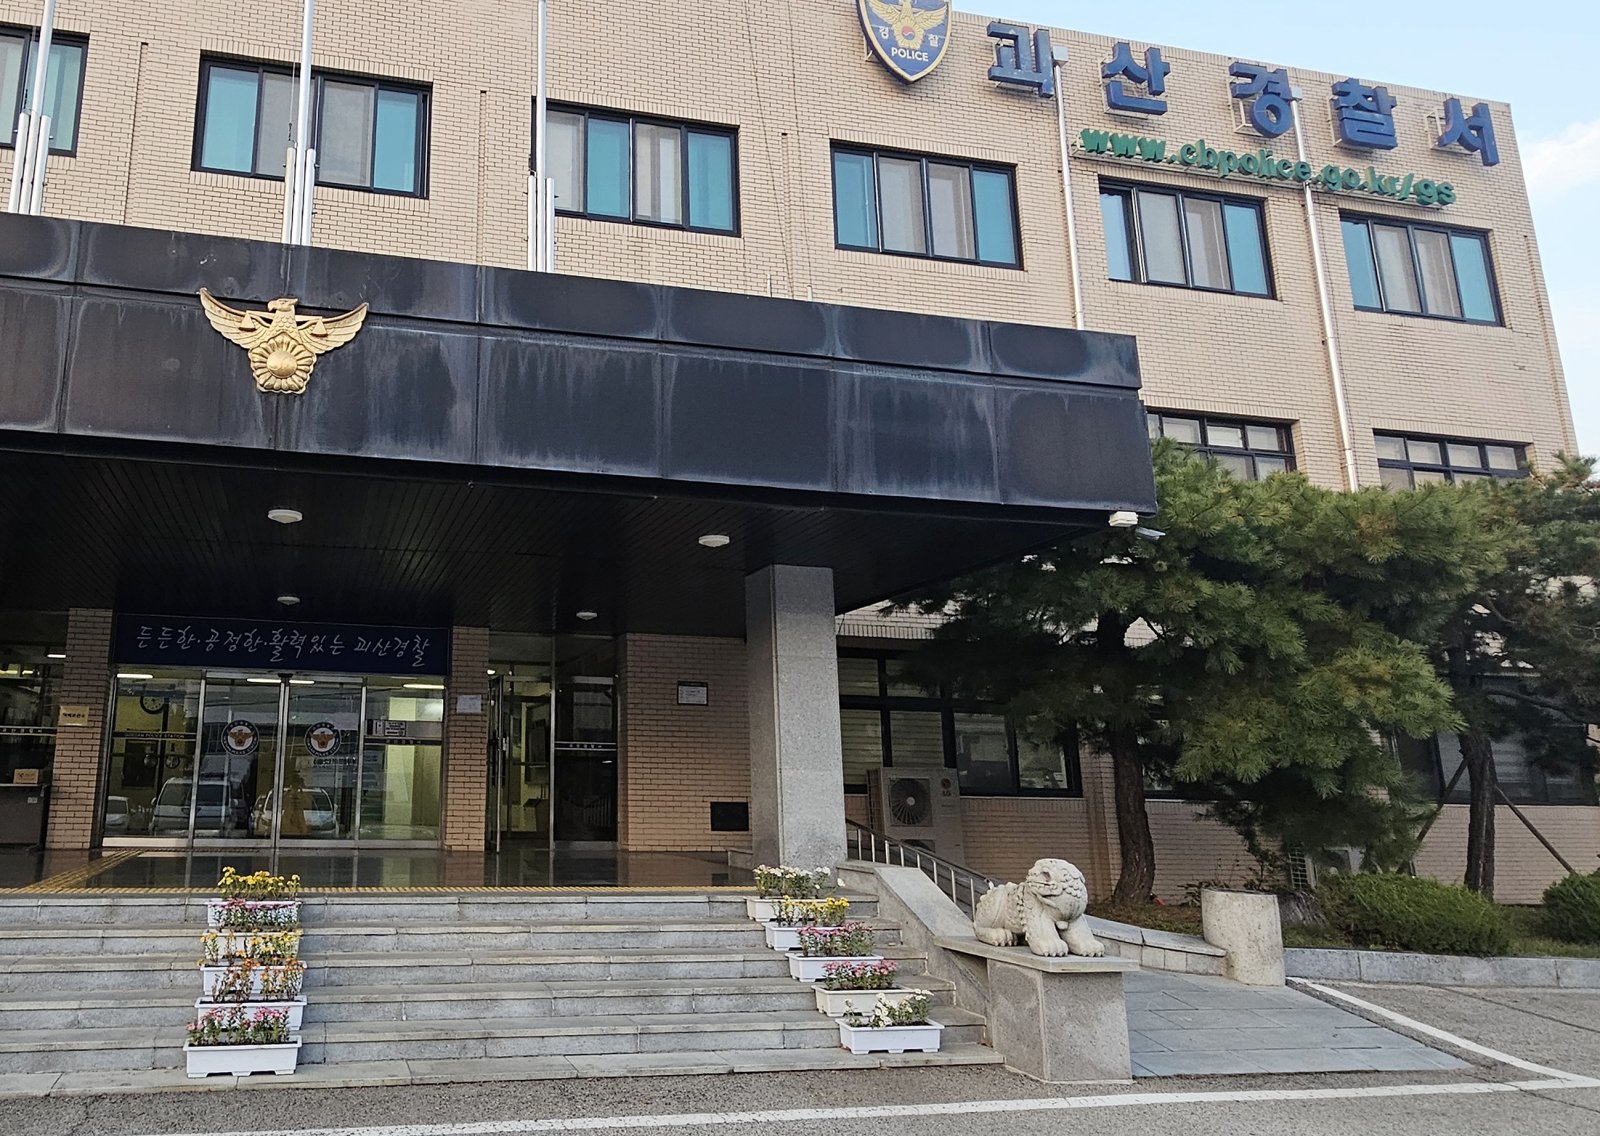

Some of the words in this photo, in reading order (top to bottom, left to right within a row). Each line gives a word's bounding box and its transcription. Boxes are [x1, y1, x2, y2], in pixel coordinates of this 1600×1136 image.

[879, 25, 889, 39] 경
[928, 33, 938, 47] 찰
[891, 47, 929, 62] POLICE
[986, 20, 1500, 167] 괴산경찰서
[1080, 128, 1457, 206] www.cbpolice.go.kr/gs
[353, 634, 430, 667] 괴산경찰
